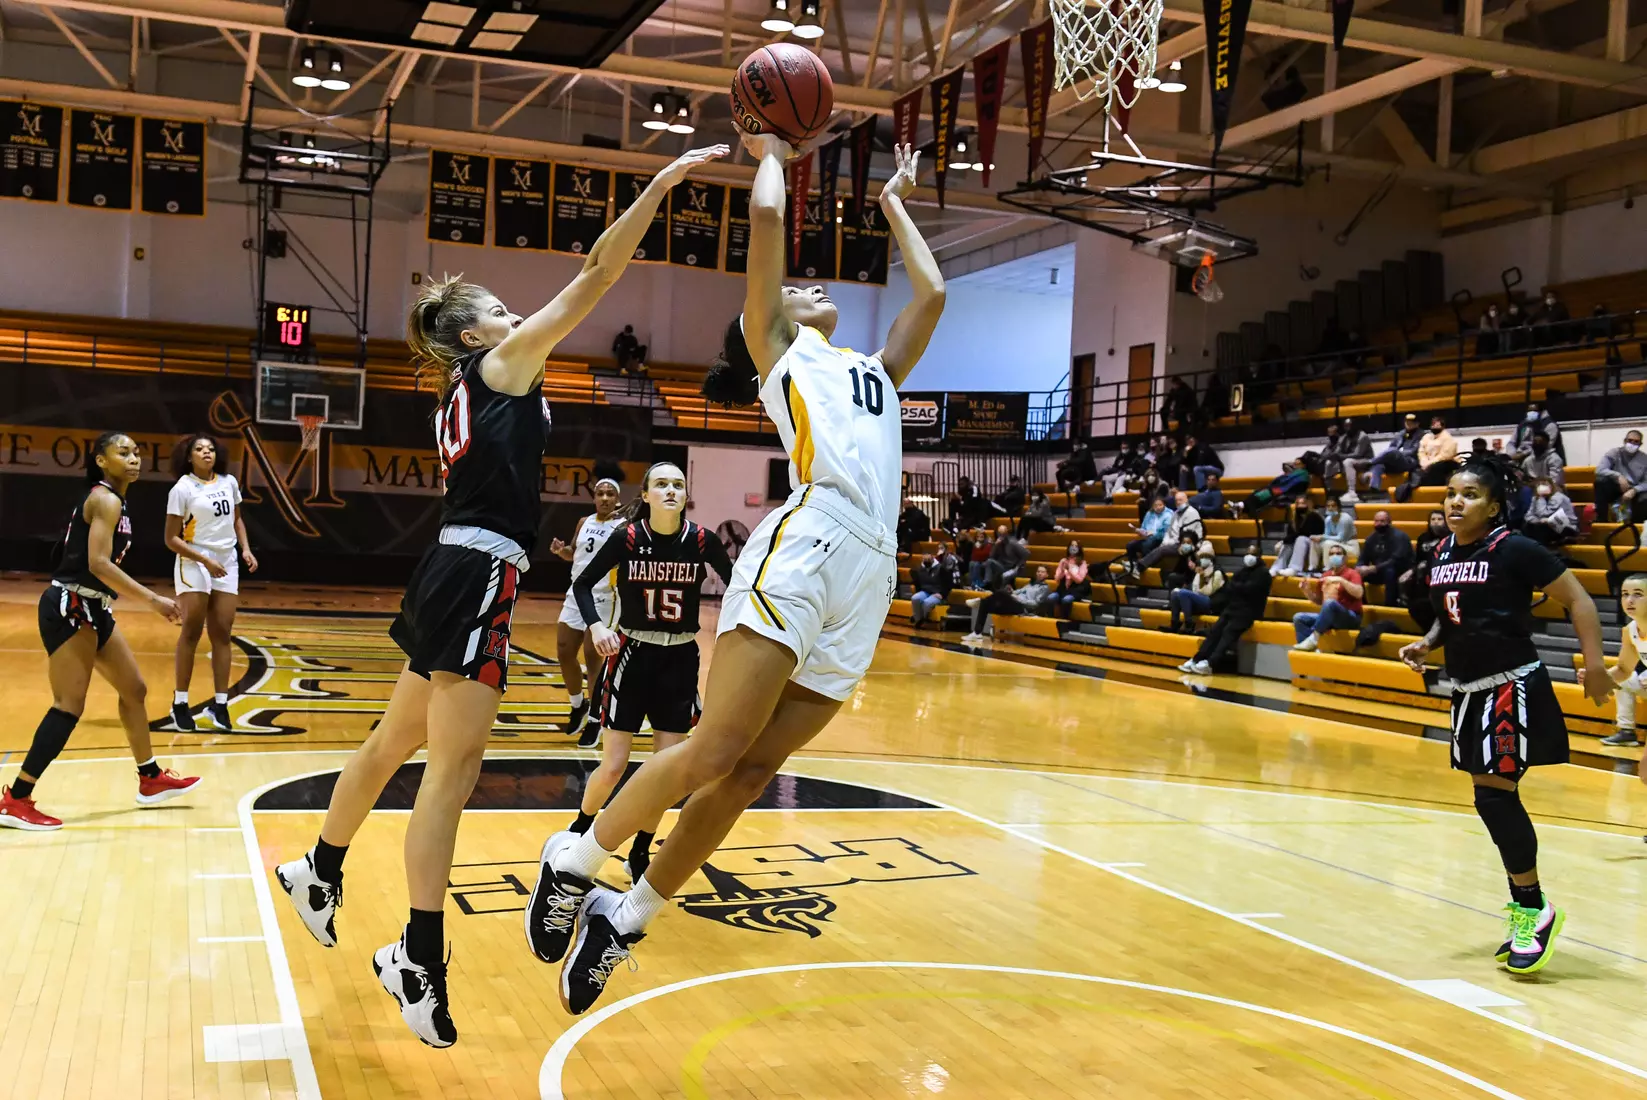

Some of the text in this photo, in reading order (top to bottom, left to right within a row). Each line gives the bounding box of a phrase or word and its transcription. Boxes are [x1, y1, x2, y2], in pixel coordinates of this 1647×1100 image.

[980, 51, 1000, 121] IUP
[936, 81, 951, 173] GANNON
[10, 134, 49, 147] FOOTBALL
[456, 184, 485, 194] SOCCER
[794, 166, 803, 245] CALIFORNIA
[276, 307, 307, 323] 6:11
[281, 322, 302, 345] 10
[848, 366, 883, 416] 10
[901, 407, 936, 419] PSAC
[972, 411, 998, 420] SPORT
[956, 420, 1015, 430] MANAGEMENT
[0, 432, 39, 467] E
[212, 499, 230, 517] 30
[585, 537, 594, 553] 3
[643, 588, 683, 622] 15
[483, 629, 508, 660] M
[1494, 734, 1516, 755] M
